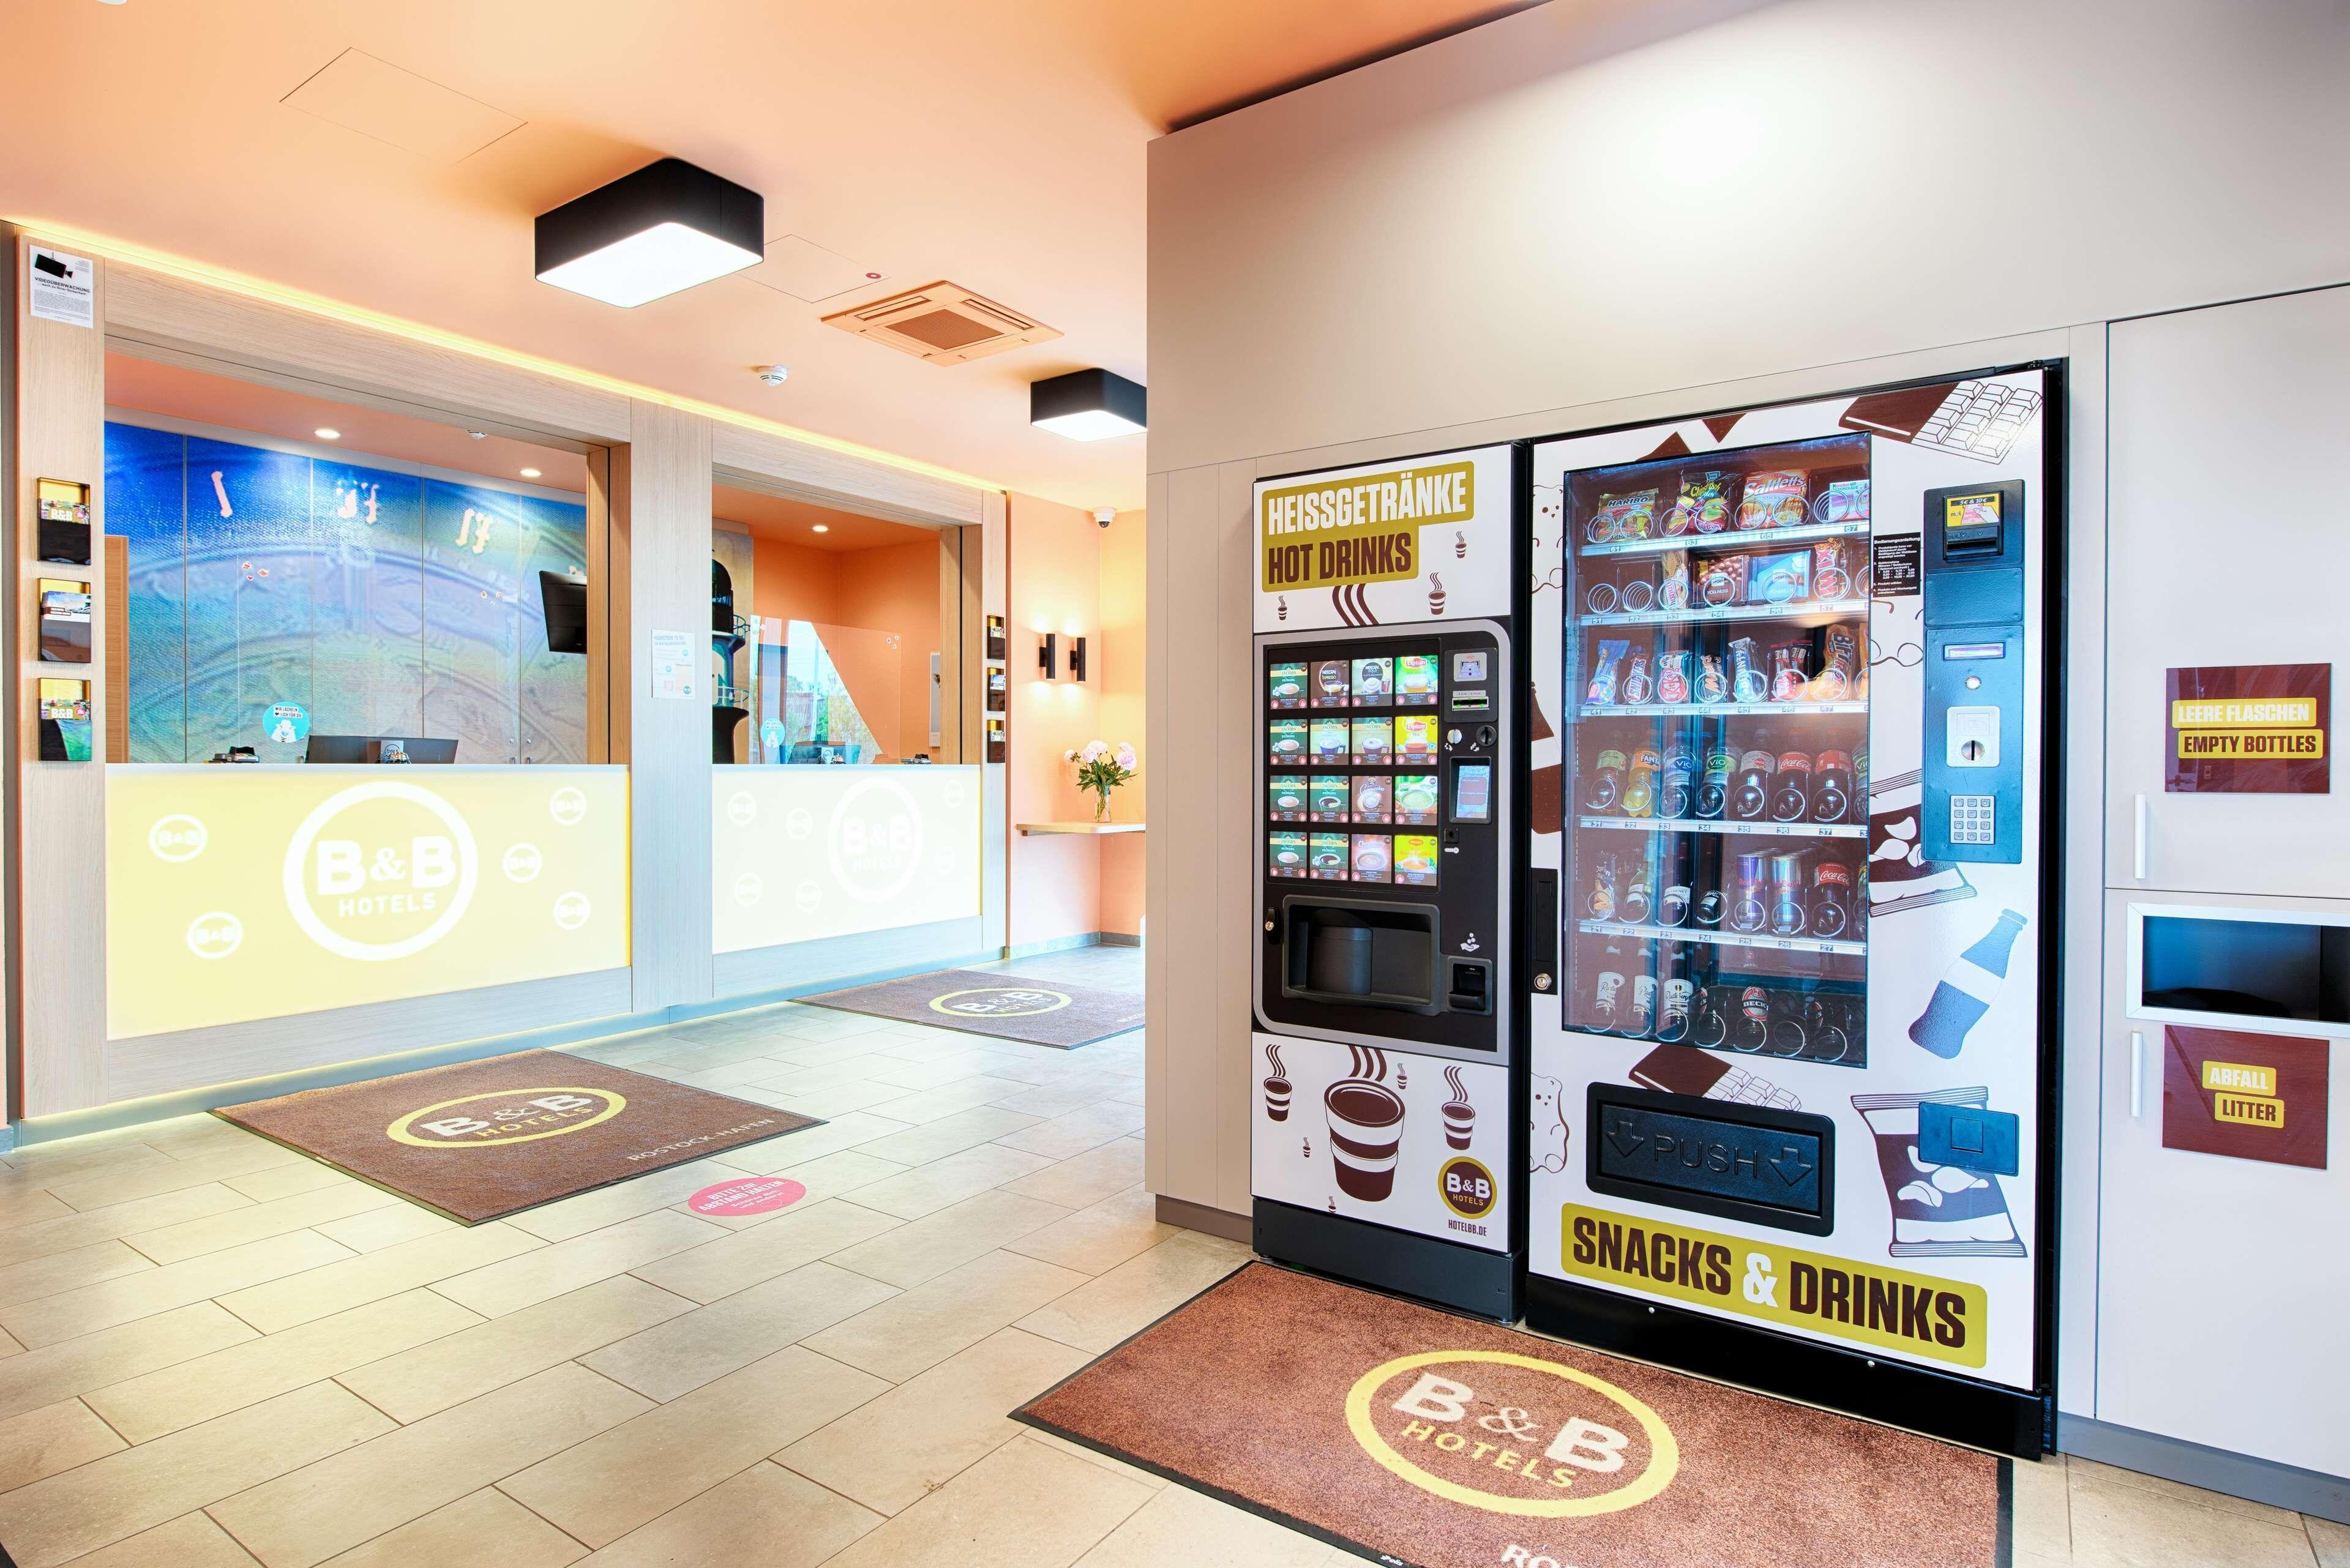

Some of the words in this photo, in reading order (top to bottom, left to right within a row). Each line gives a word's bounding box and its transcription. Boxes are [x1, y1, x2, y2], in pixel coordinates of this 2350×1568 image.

[35, 277, 90, 293] VIDEOÜBERWACHUNG
[1745, 477, 1806, 497] Saltletts
[1268, 471, 1466, 536] HEISSGETRÄNKE
[1607, 496, 1649, 508] HARIBO
[1268, 543, 1313, 584] HOT
[1319, 532, 1412, 580] DRINKS
[51, 708, 73, 719] B&B
[2179, 705, 2223, 722] LEERE
[2226, 704, 2309, 722] FLASCHEN
[2184, 736, 2240, 753] EMPTY
[2243, 735, 2316, 753] BOTTLES
[316, 835, 456, 895] B&B
[339, 892, 436, 917] HOTELS
[951, 991, 1044, 1012] B&B
[2210, 1067, 2269, 1090] ABFALL
[421, 1095, 593, 1137] B&B
[2222, 1099, 2276, 1121] LITTER
[475, 1107, 593, 1137] HOTELS
[627, 1119, 775, 1161] ROSTOCK-HAFEN
[1655, 1133, 1759, 1179] PUSH
[706, 1187, 739, 1200] BITTE
[736, 1182, 758, 1191] 2m
[1447, 1172, 1491, 1198] B&B
[698, 1193, 750, 1211] ABSTAND
[1453, 1194, 1484, 1206] HOTELS
[1448, 1219, 1487, 1236] HOTELBB.DE
[1573, 1215, 1732, 1296] SNACKS
[1742, 1252, 1779, 1309] &
[1789, 1261, 1966, 1348] DRINKS
[1391, 1372, 1630, 1473] B&B
[1401, 1421, 1574, 1489] HOTELS
